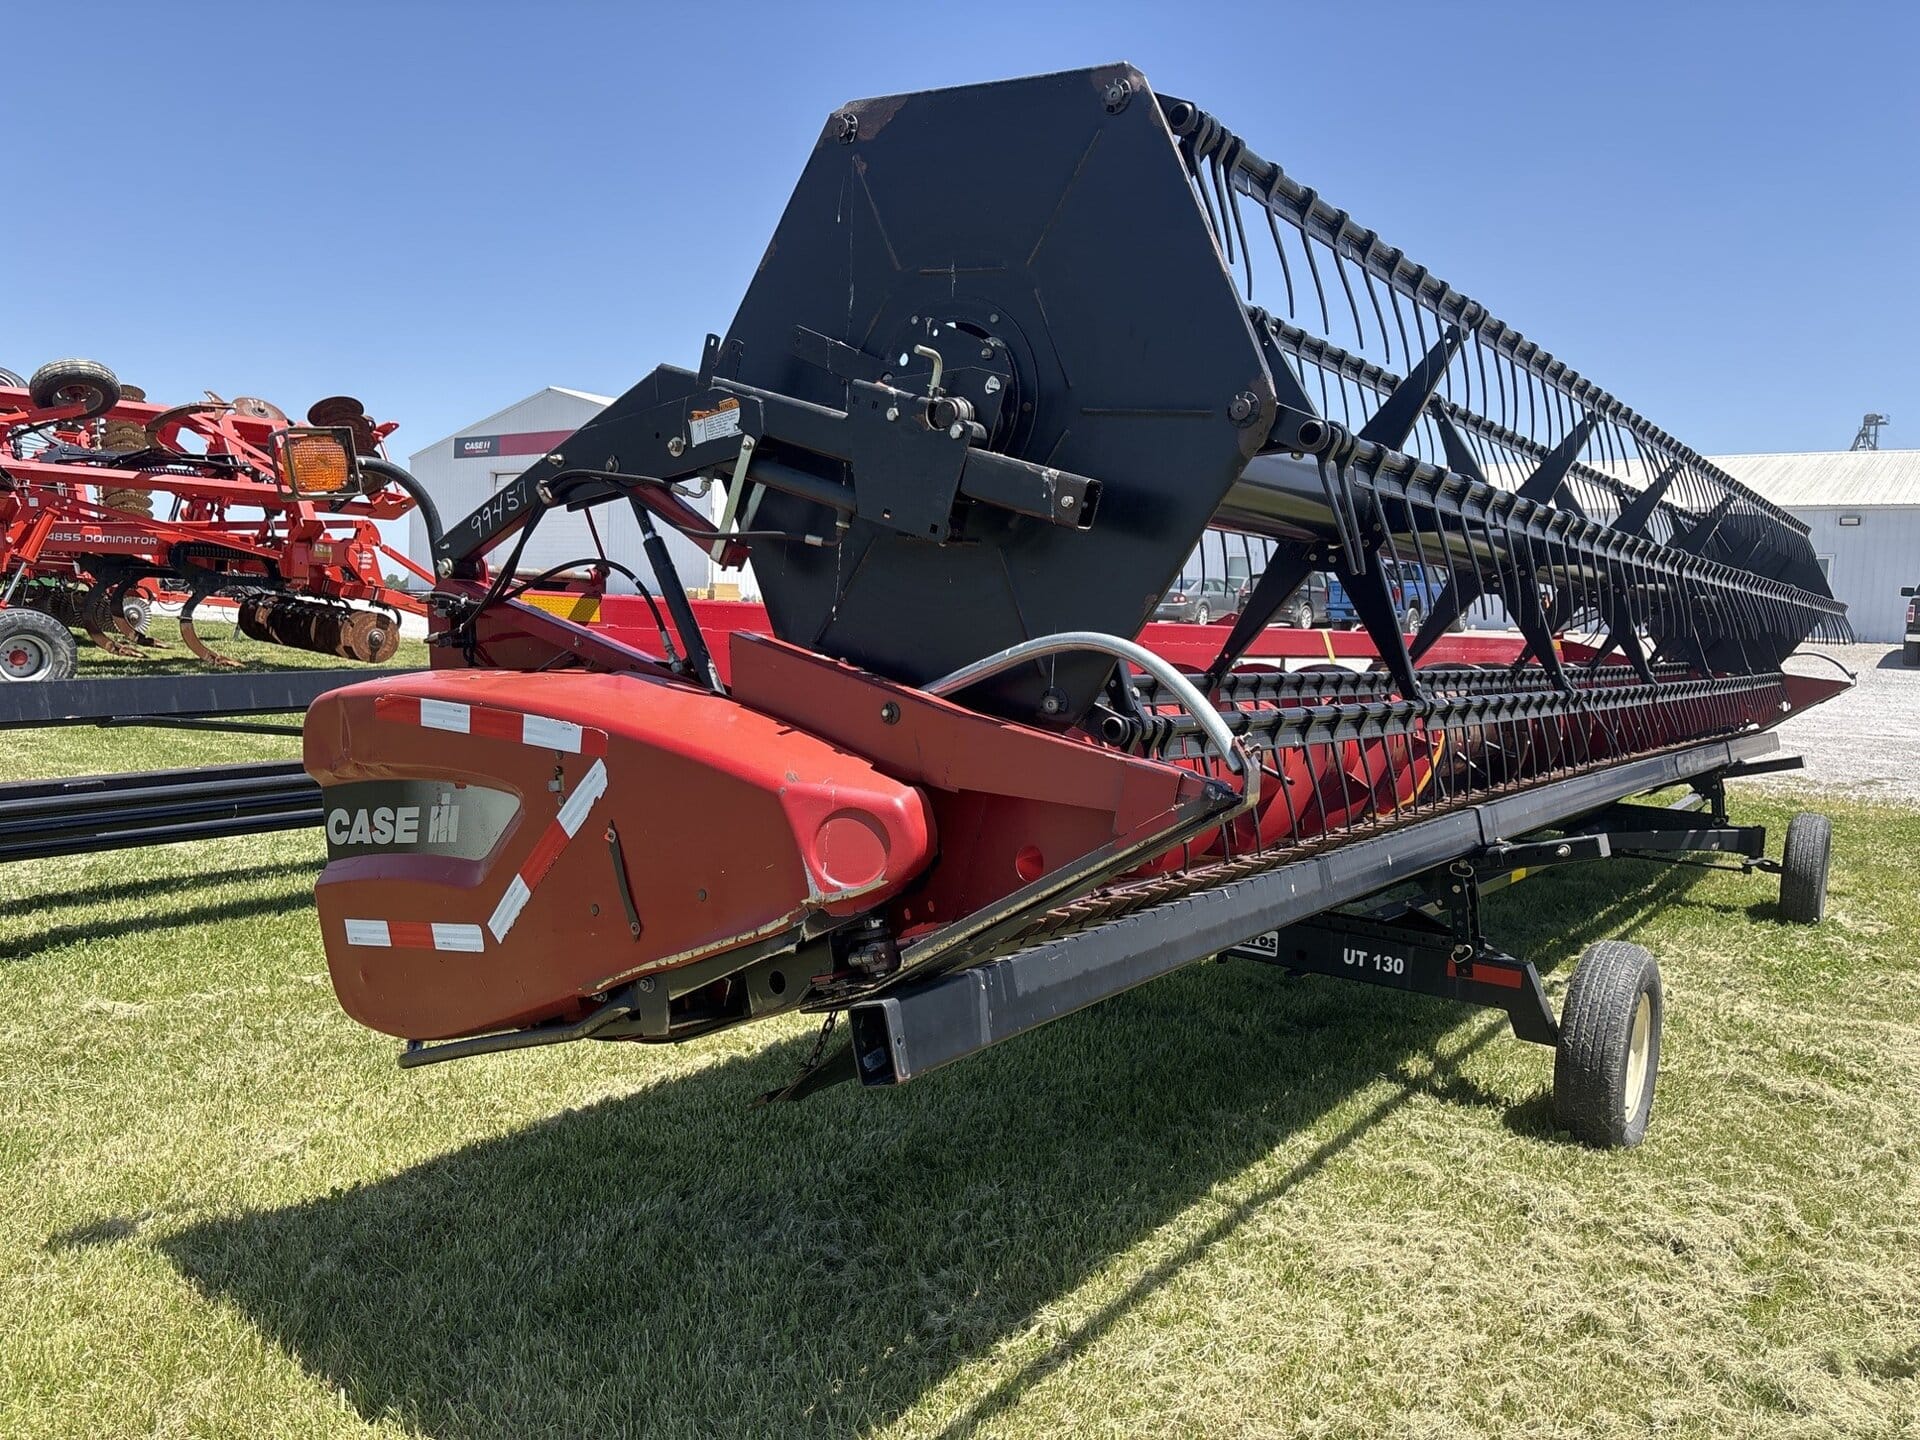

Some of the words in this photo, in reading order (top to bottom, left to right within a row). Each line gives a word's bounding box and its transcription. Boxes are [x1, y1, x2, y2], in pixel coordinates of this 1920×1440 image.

[464, 441, 484, 450] CASE
[471, 480, 527, 538] 99457
[47, 532, 81, 542] 4855
[84, 534, 158, 545] DOMINATOR
[327, 806, 420, 845] CASE
[1343, 948, 1368, 967] UT
[1372, 954, 1404, 974] 130
